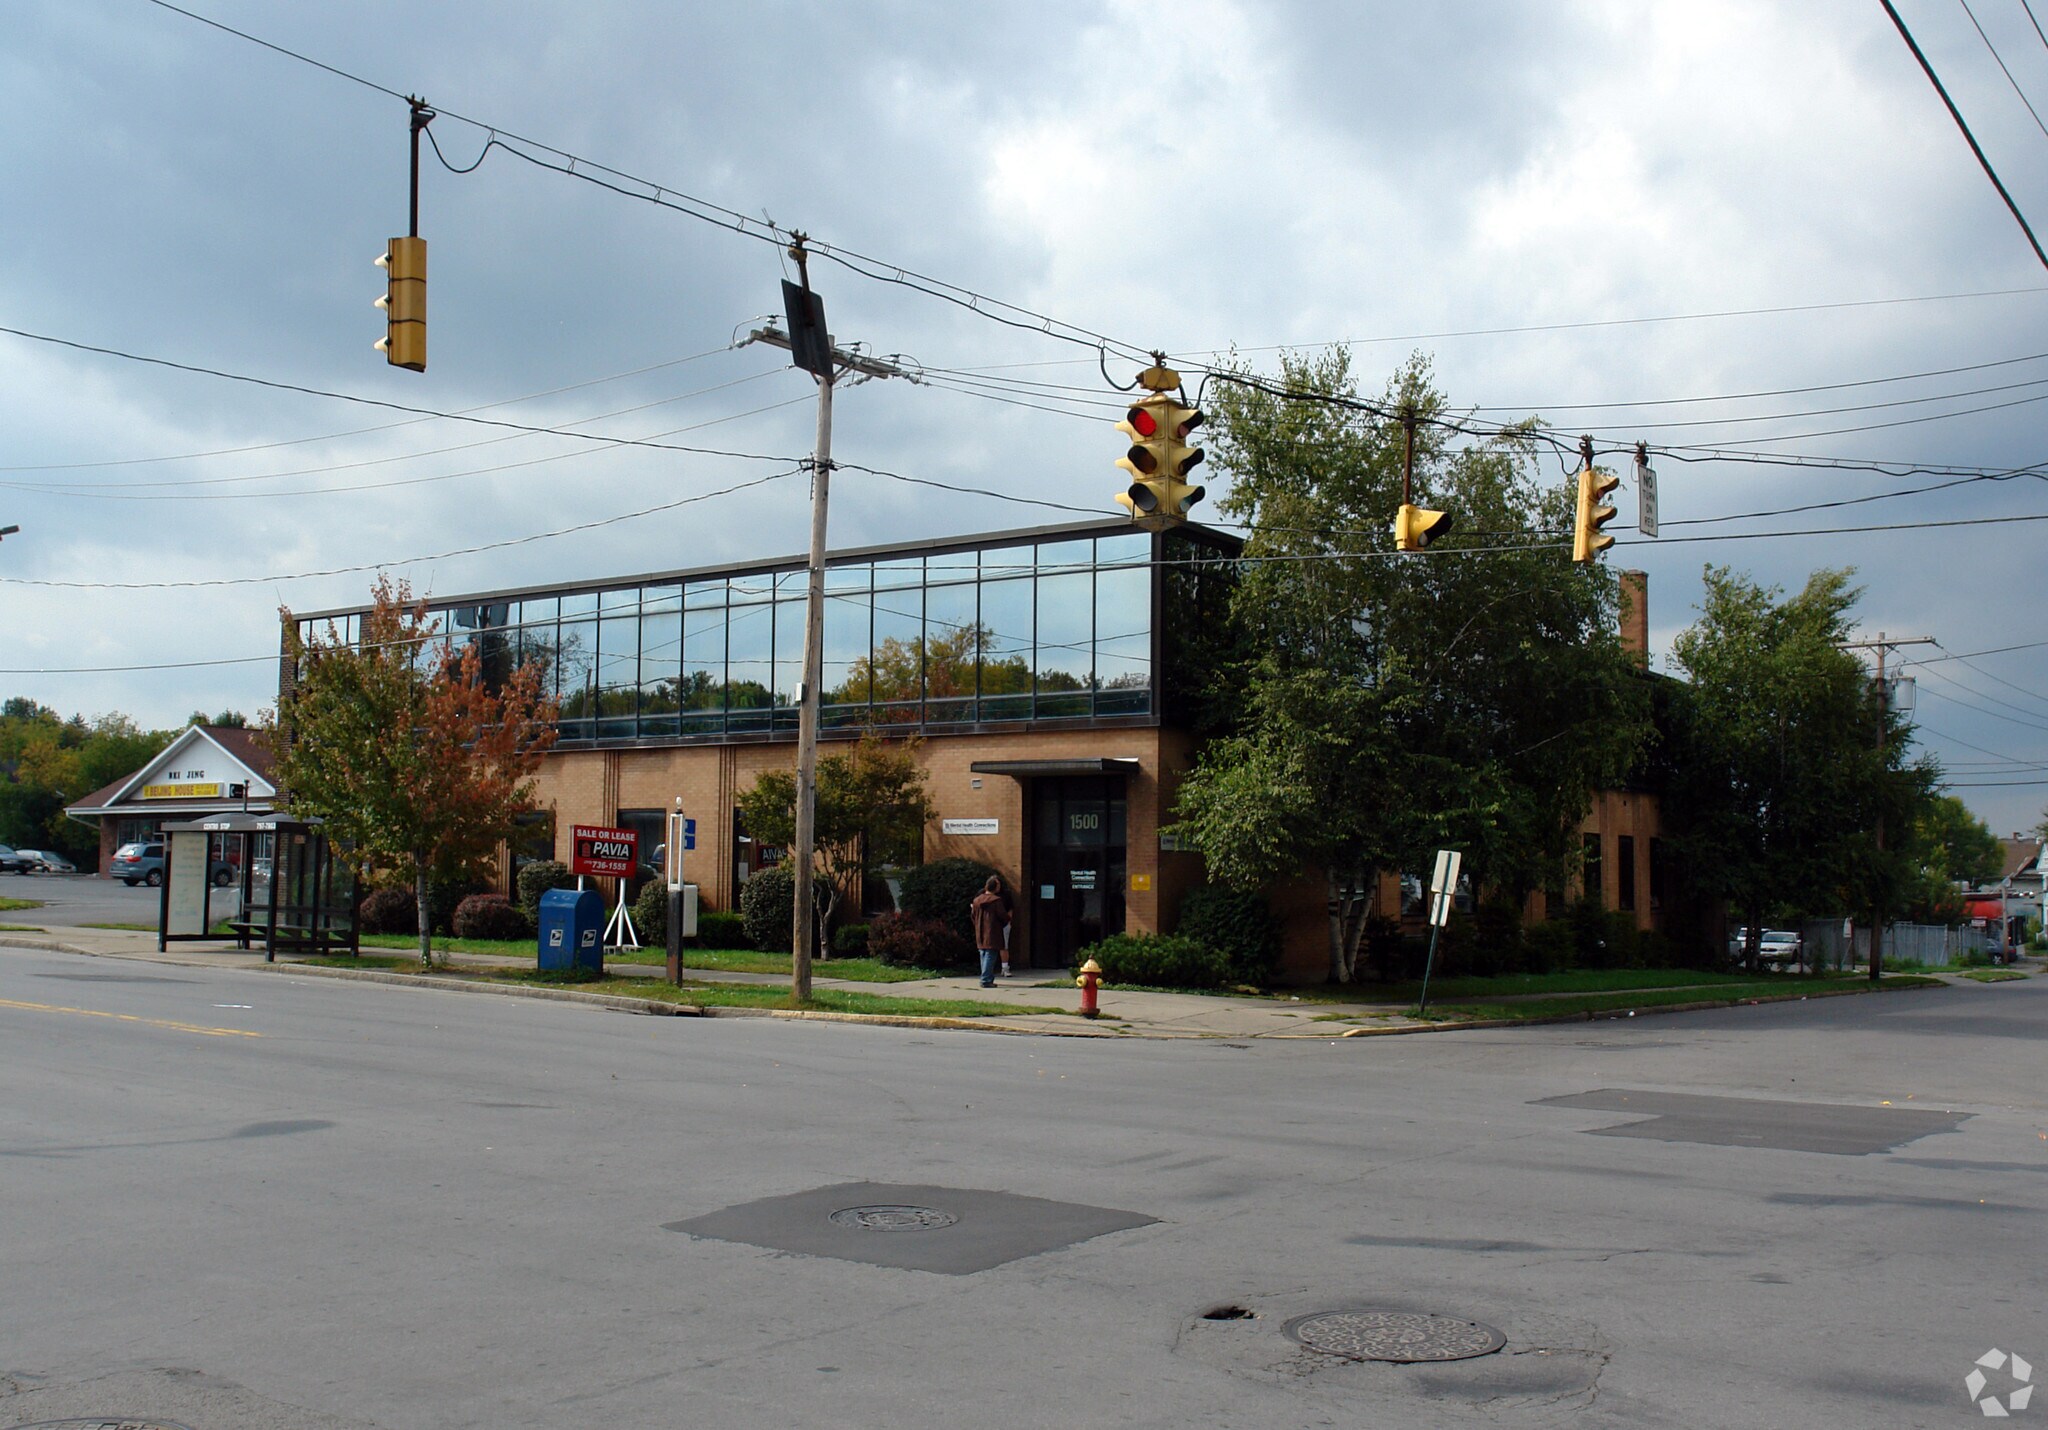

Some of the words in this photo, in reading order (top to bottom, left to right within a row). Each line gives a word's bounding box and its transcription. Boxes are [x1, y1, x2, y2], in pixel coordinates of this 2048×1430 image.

[1643, 474, 1653, 489] NO
[1644, 515, 1654, 528] RED
[187, 770, 205, 779] JING
[1070, 814, 1098, 829] 1500
[576, 829, 597, 838] SALE
[598, 831, 610, 839] OR
[611, 832, 636, 841] LEASE
[593, 841, 630, 857] PAVIA
